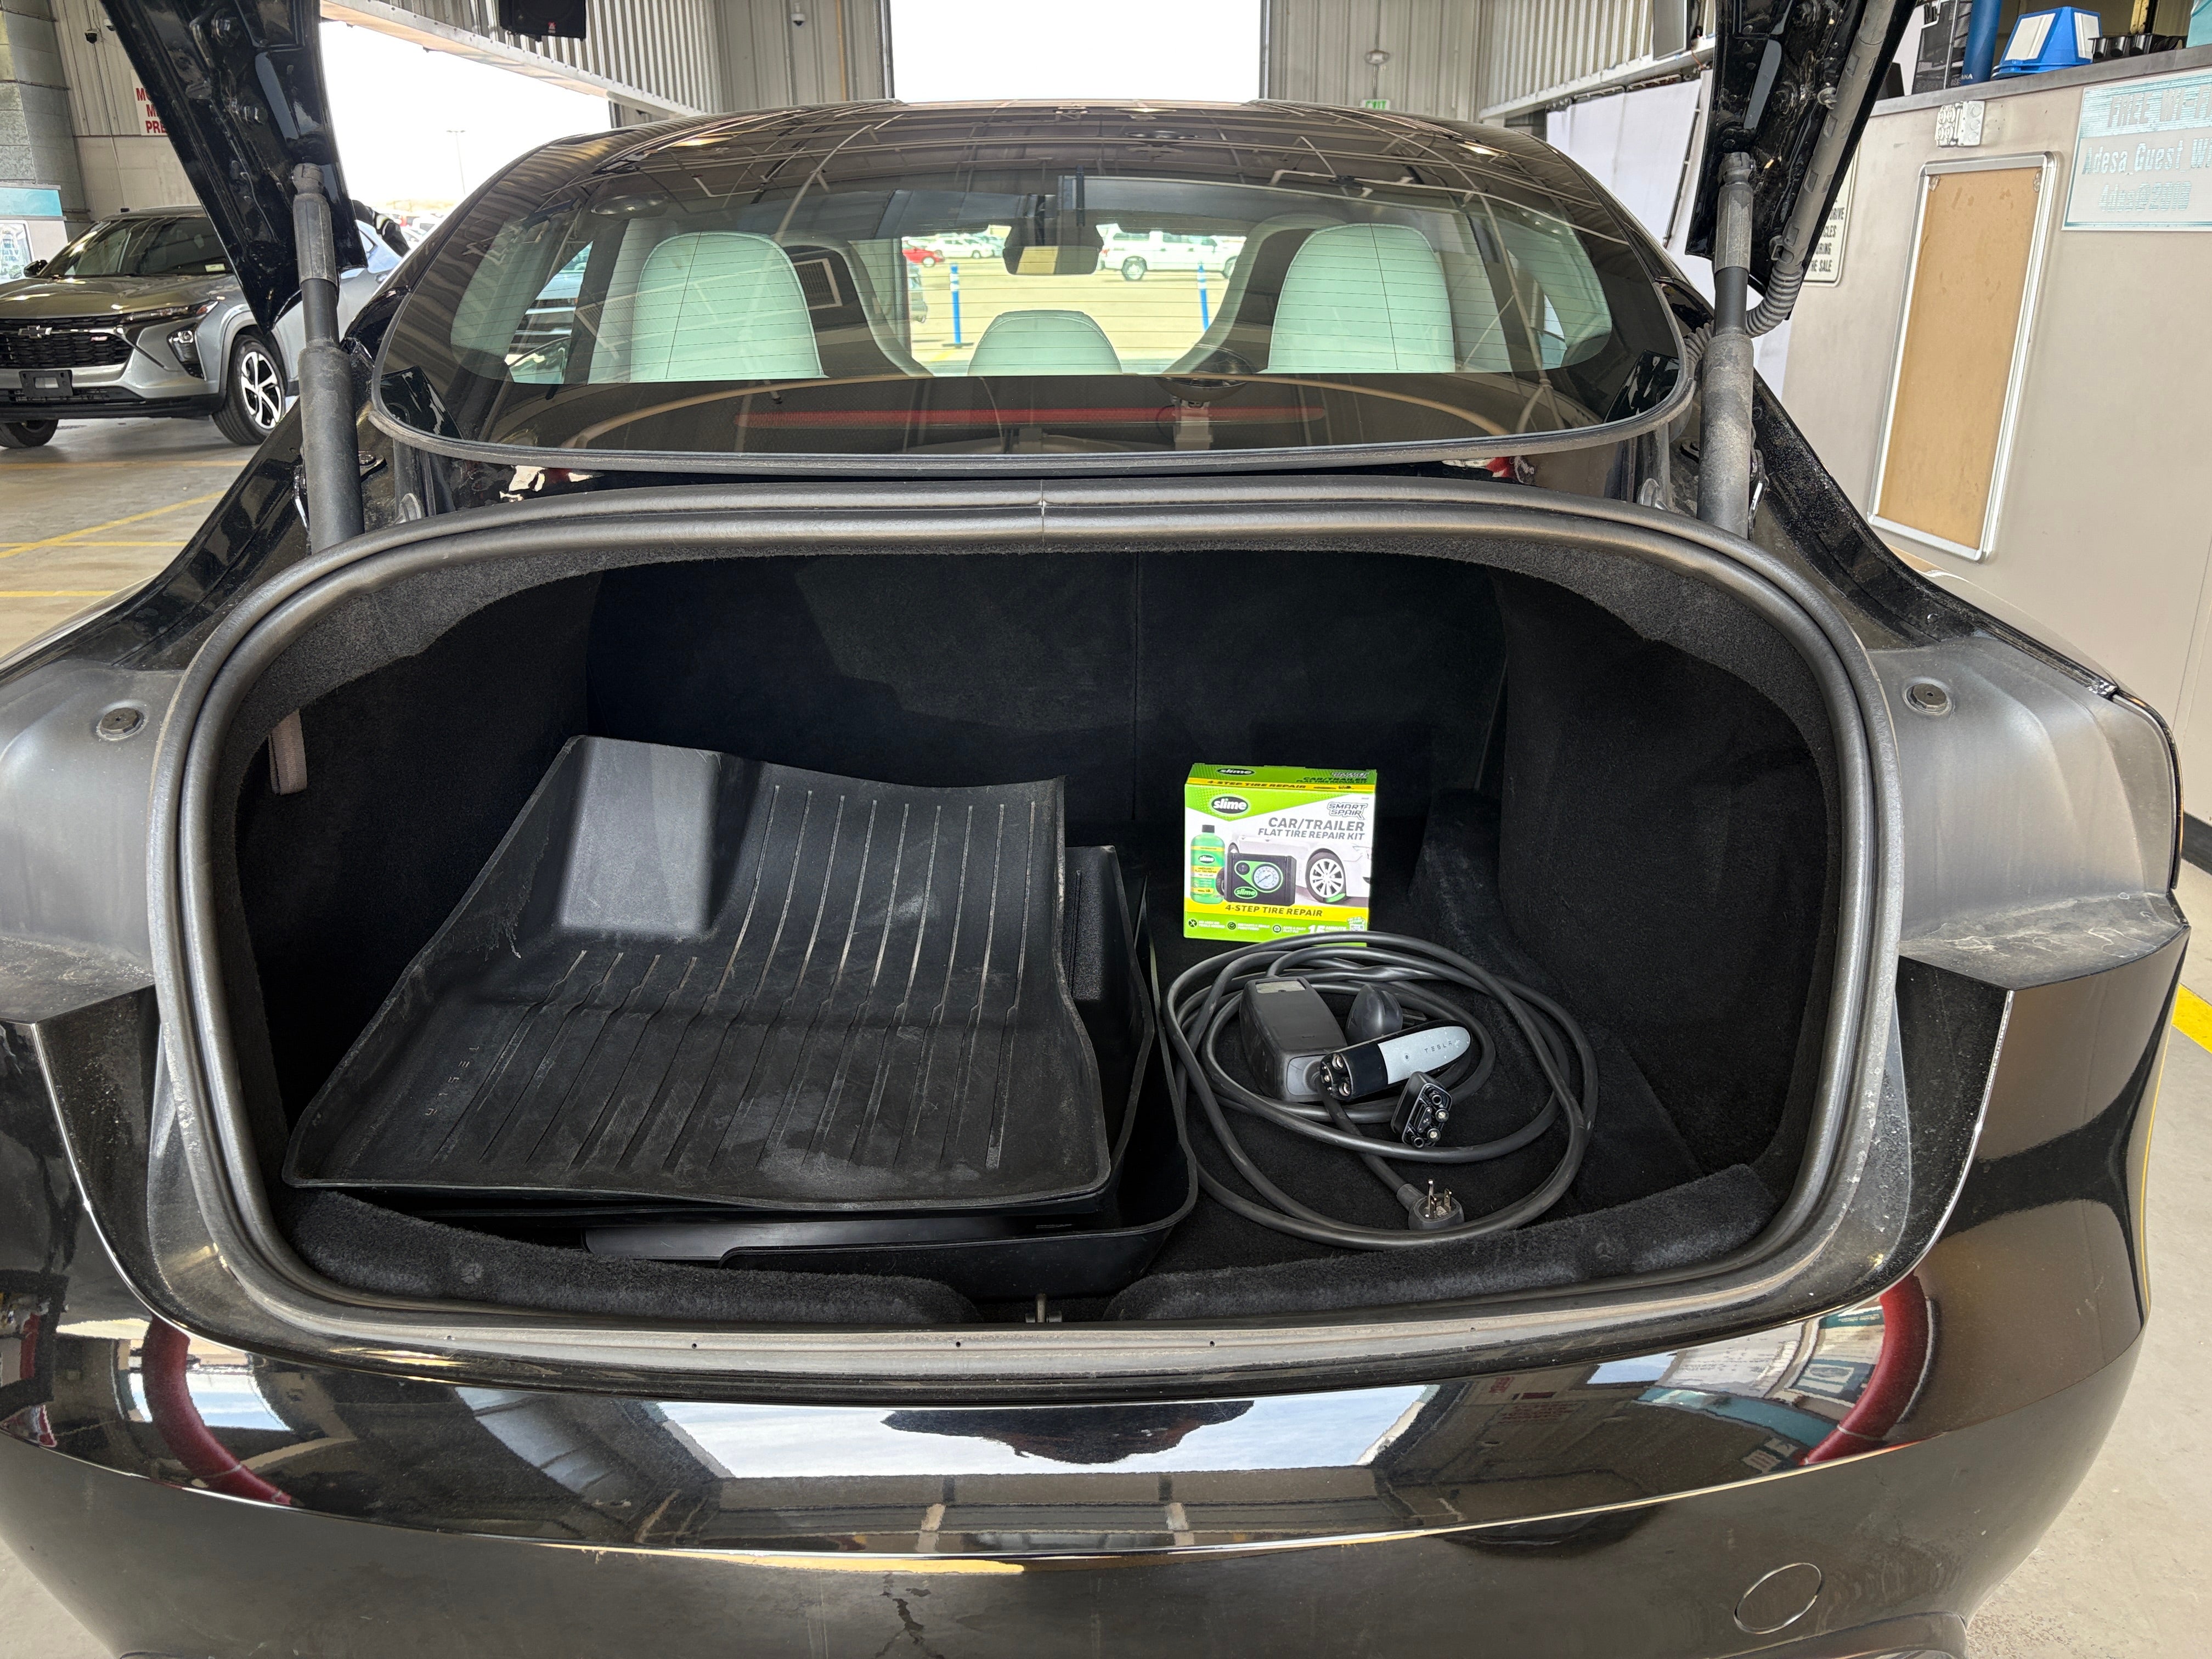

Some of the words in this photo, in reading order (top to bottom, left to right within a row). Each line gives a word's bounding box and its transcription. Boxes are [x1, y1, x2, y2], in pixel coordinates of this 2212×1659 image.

[2108, 92, 2154, 127] FREE
[145, 120, 167, 133] PRE
[1821, 225, 1836, 238] CLES
[1816, 242, 1832, 255] URING
[1819, 259, 1832, 272] SALE
[1213, 798, 1247, 810] slime
[1330, 809, 1363, 819] SPAIR
[1268, 817, 1365, 832] CAR/TRAILER
[1258, 828, 1283, 836] FLAT
[1284, 829, 1307, 838] TIRE
[1308, 831, 1346, 840] REPAIR
[1347, 832, 1365, 840] KIT
[1236, 888, 1255, 896] slime
[1225, 904, 1260, 913] 4-STEP
[1262, 906, 1284, 915] TIRE
[1286, 908, 1323, 917] REPAIR
[1424, 1040, 1452, 1053] TESLA
